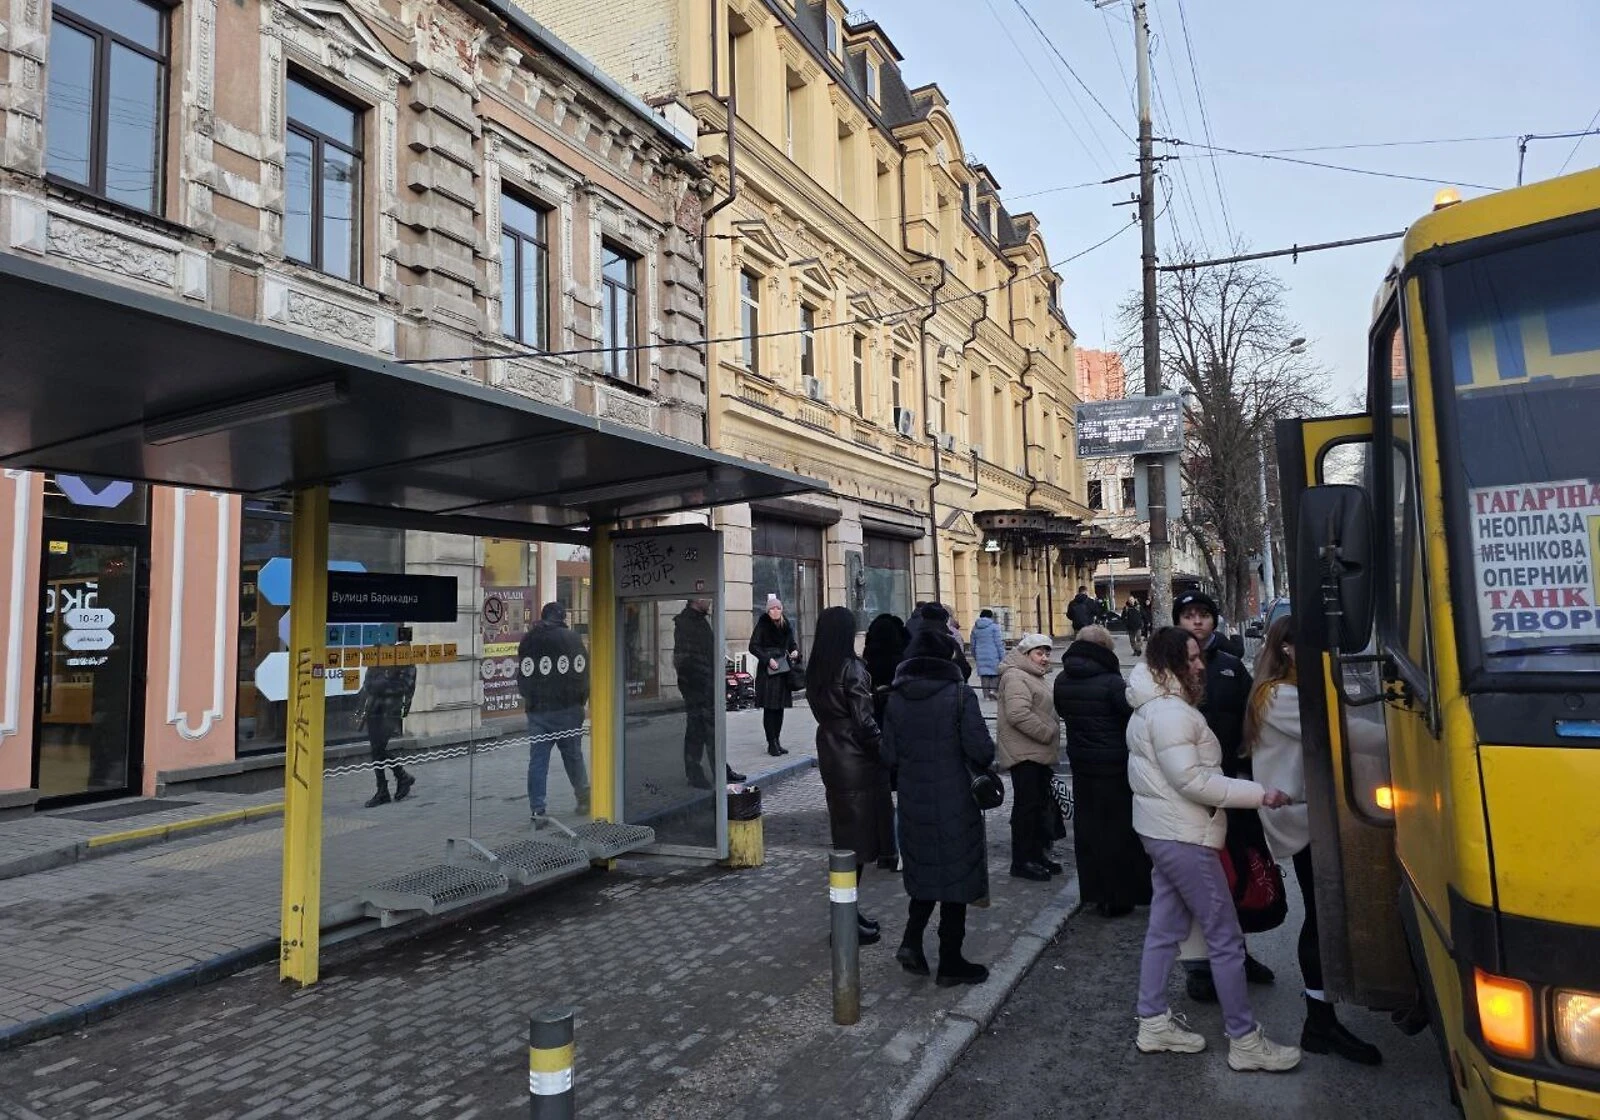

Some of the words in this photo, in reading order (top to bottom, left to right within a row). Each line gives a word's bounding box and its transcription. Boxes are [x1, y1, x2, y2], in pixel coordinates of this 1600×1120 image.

[1479, 512, 1585, 538] НЕОПЛАЗА
[1482, 539, 1586, 562] МЕЧНІКОВА
[1483, 560, 1588, 587] ОПЕРНИЙ
[332, 592, 368, 604] Вулиця
[370, 592, 419, 605] Барикадна
[1484, 587, 1590, 609] ТАНК
